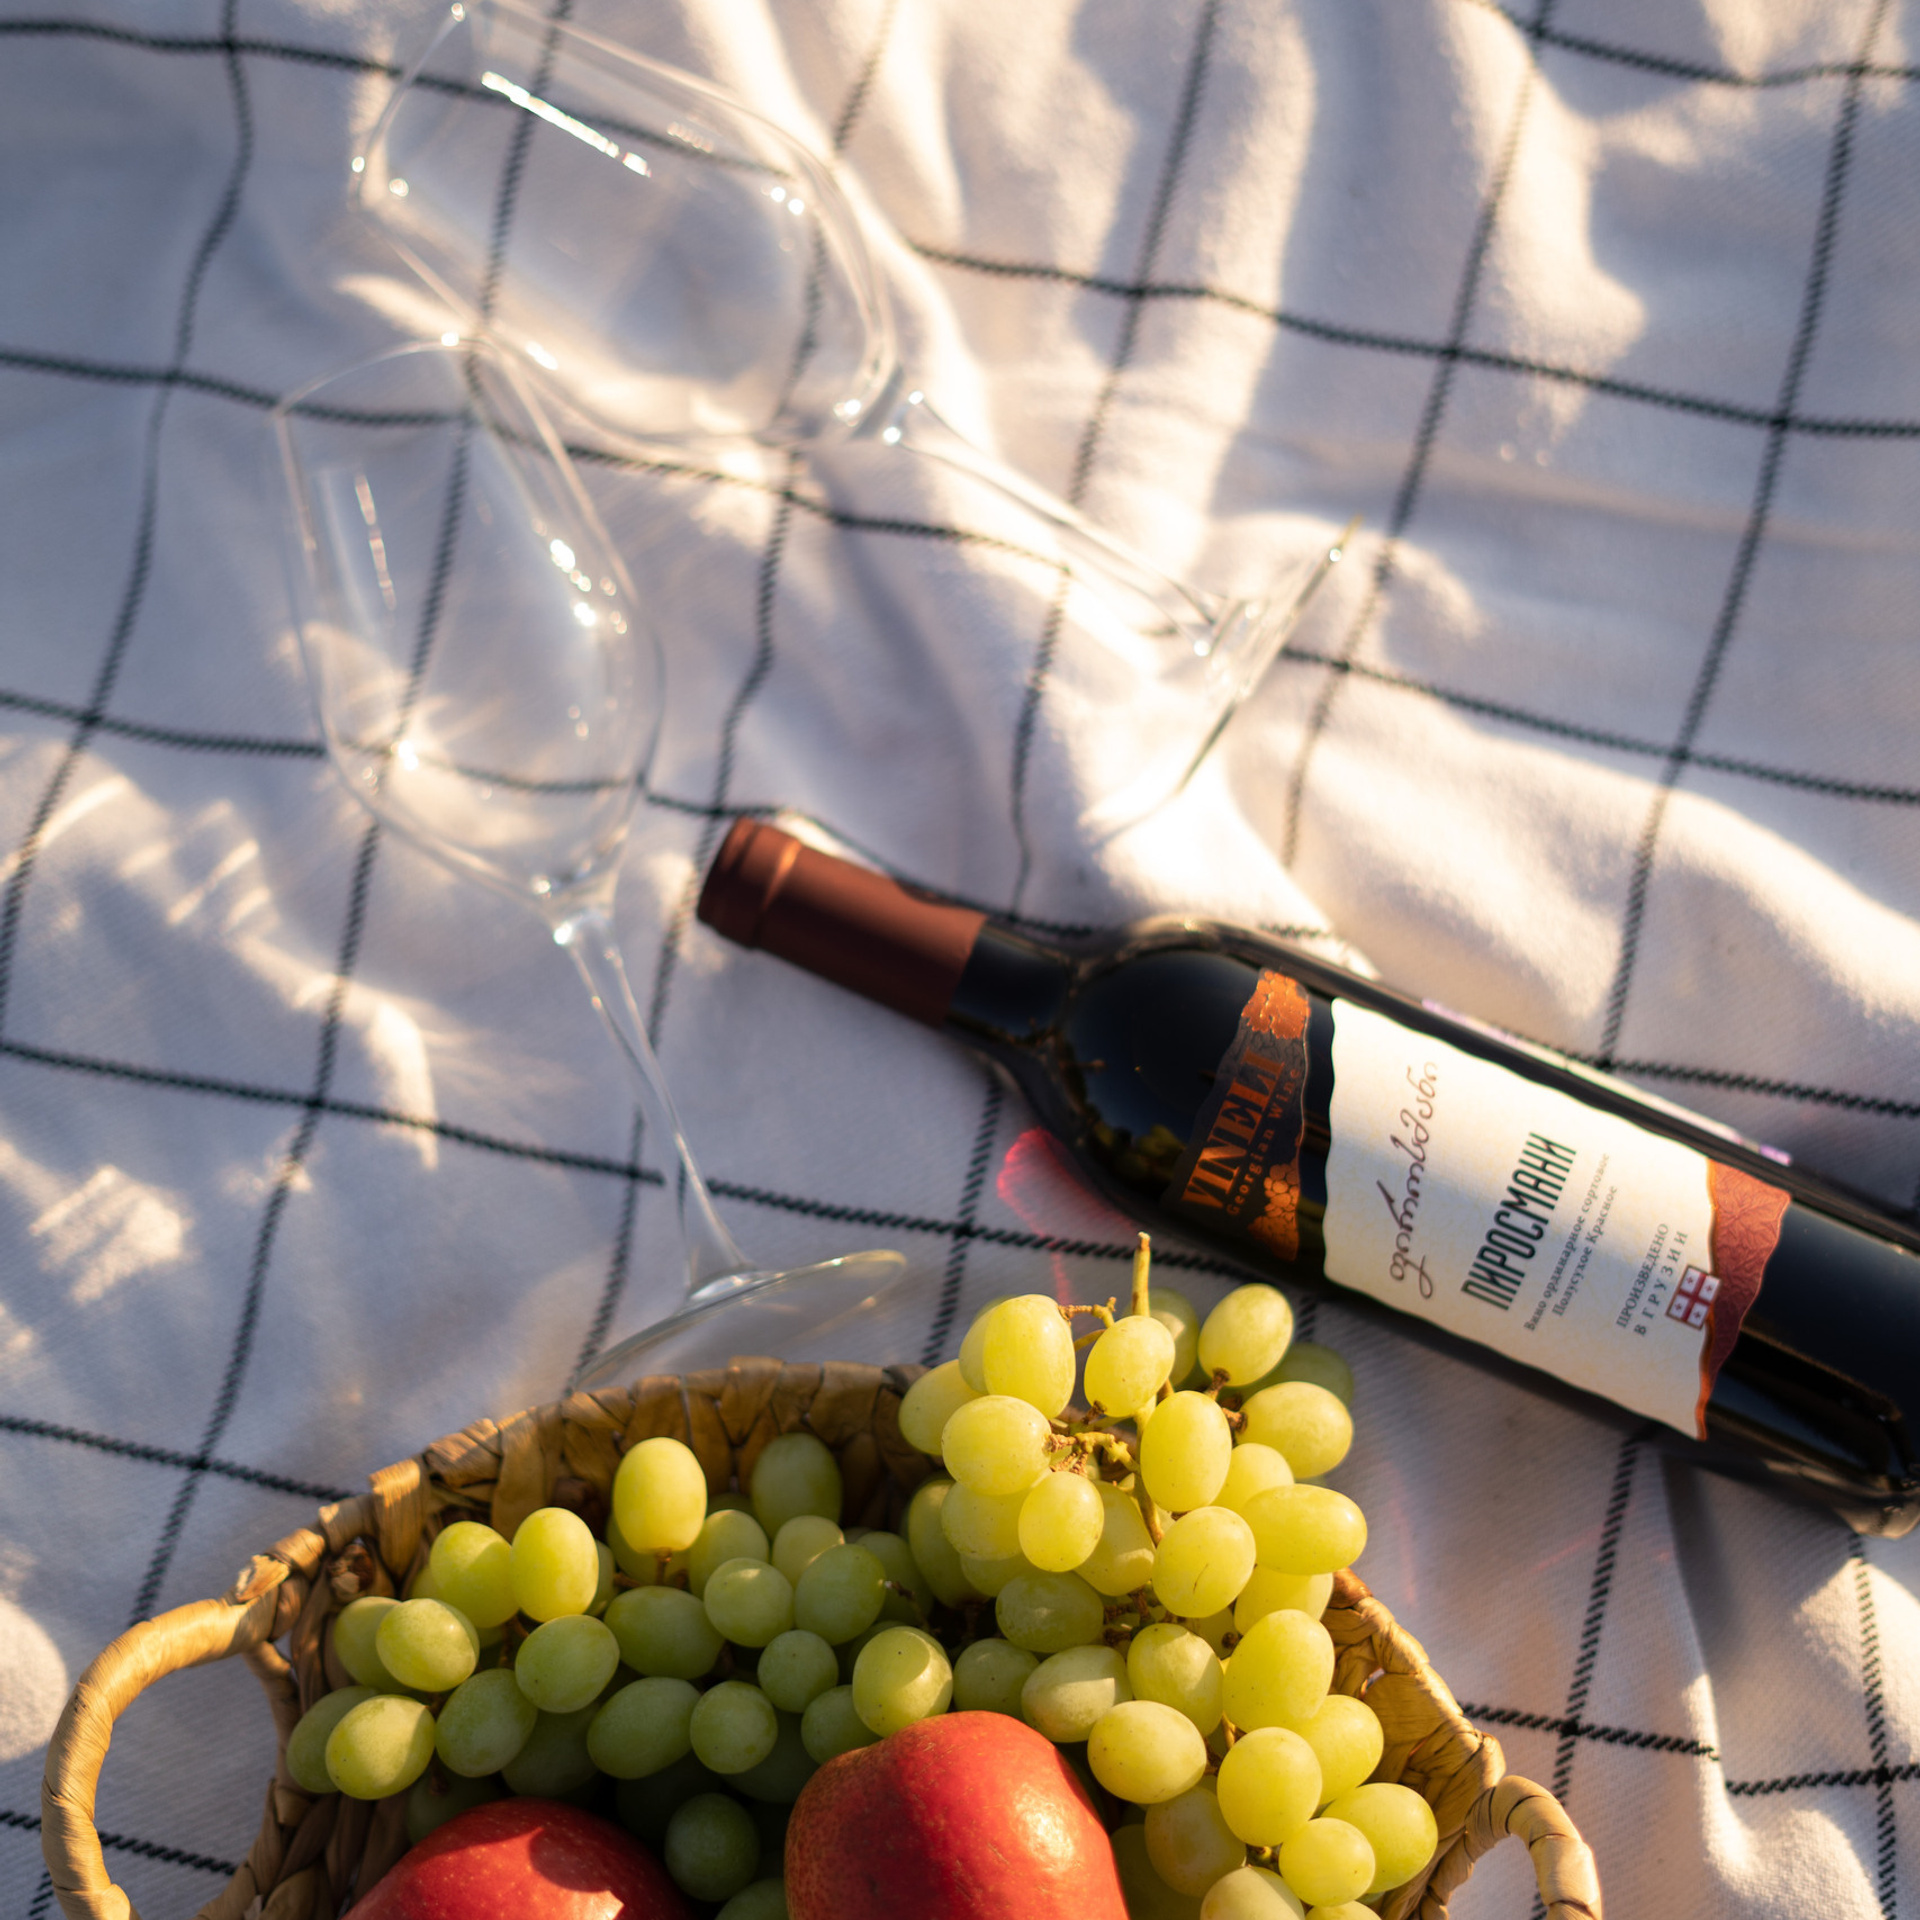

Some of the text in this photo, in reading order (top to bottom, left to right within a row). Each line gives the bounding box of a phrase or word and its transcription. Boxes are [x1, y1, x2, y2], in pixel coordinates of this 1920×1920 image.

[1182, 1047, 1285, 1209] VINELI
[1226, 1068, 1300, 1216] Georgian Wine
[1460, 1131, 1577, 1311] ПИРОСМАНИ
[1523, 1153, 1609, 1331] Вино ординарное сортовое
[1552, 1186, 1617, 1317] Полусухое Красное
[1616, 1223, 1669, 1329] ПРОИЗВЕДЕНО
[1633, 1231, 1688, 1337] В ГРУЗИИ
